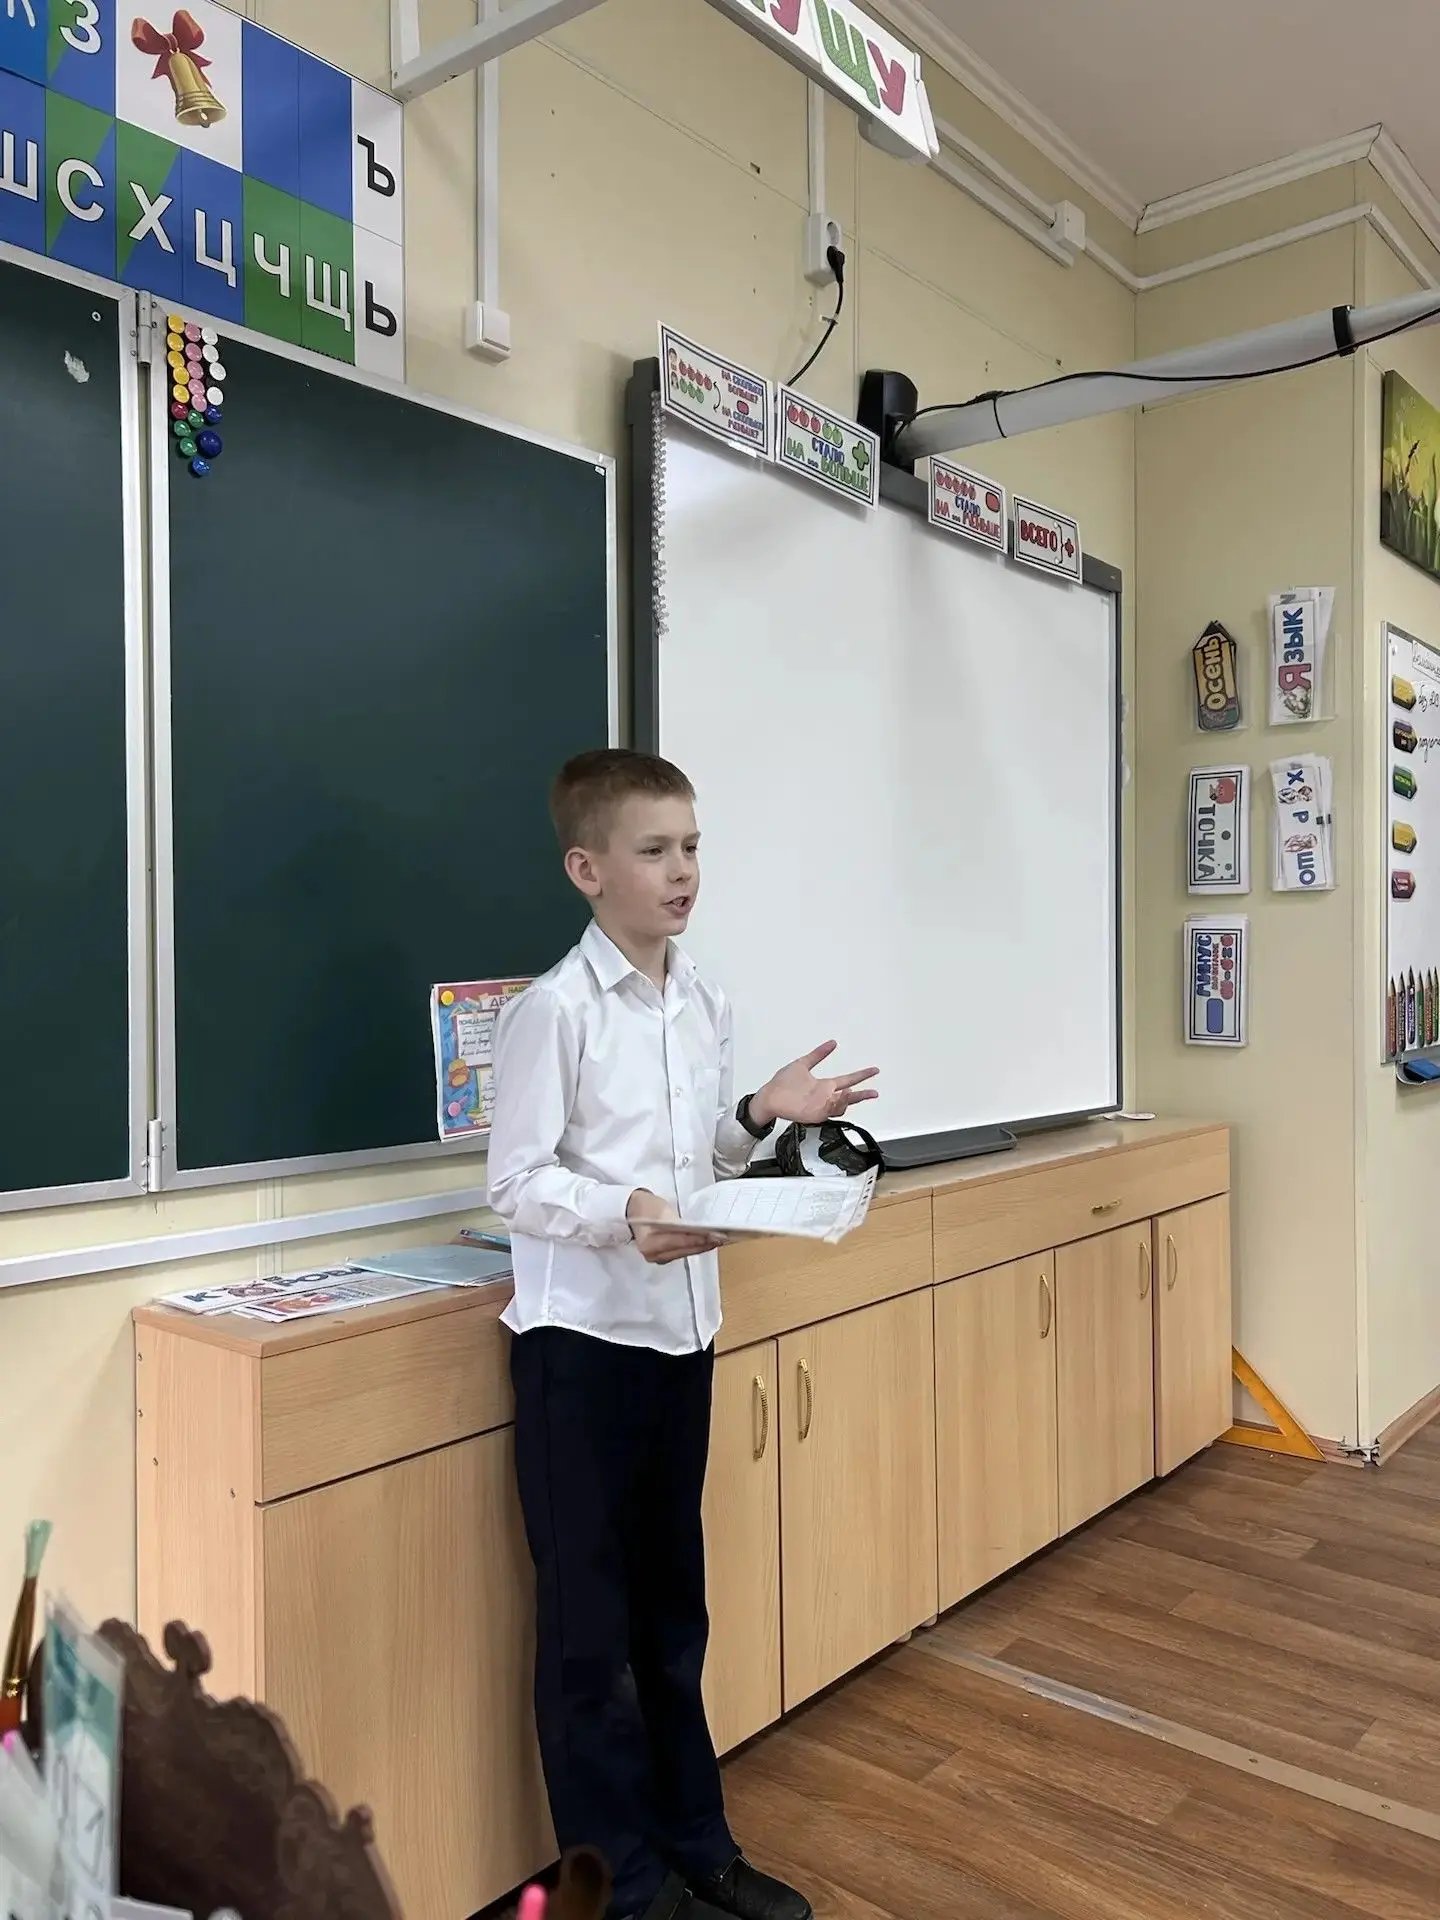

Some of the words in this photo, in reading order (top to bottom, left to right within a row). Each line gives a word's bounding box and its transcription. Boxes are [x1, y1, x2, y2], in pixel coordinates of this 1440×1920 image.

[357, 134, 396, 198] Ъ
[56, 157, 105, 222] С
[128, 182, 175, 254] Х
[195, 208, 237, 288] Ц
[253, 232, 291, 299] Ч
[305, 254, 351, 333] Щ
[364, 280, 397, 337] Ь
[786, 437, 805, 462] НА
[811, 437, 845, 466] СТАЛО
[936, 498, 950, 518] НА
[955, 495, 981, 517] СТАЛО
[1020, 519, 1058, 552] ВСЕГО
[1198, 803, 1216, 879] ТОЧКА
[1196, 934, 1212, 998] МИНУС
